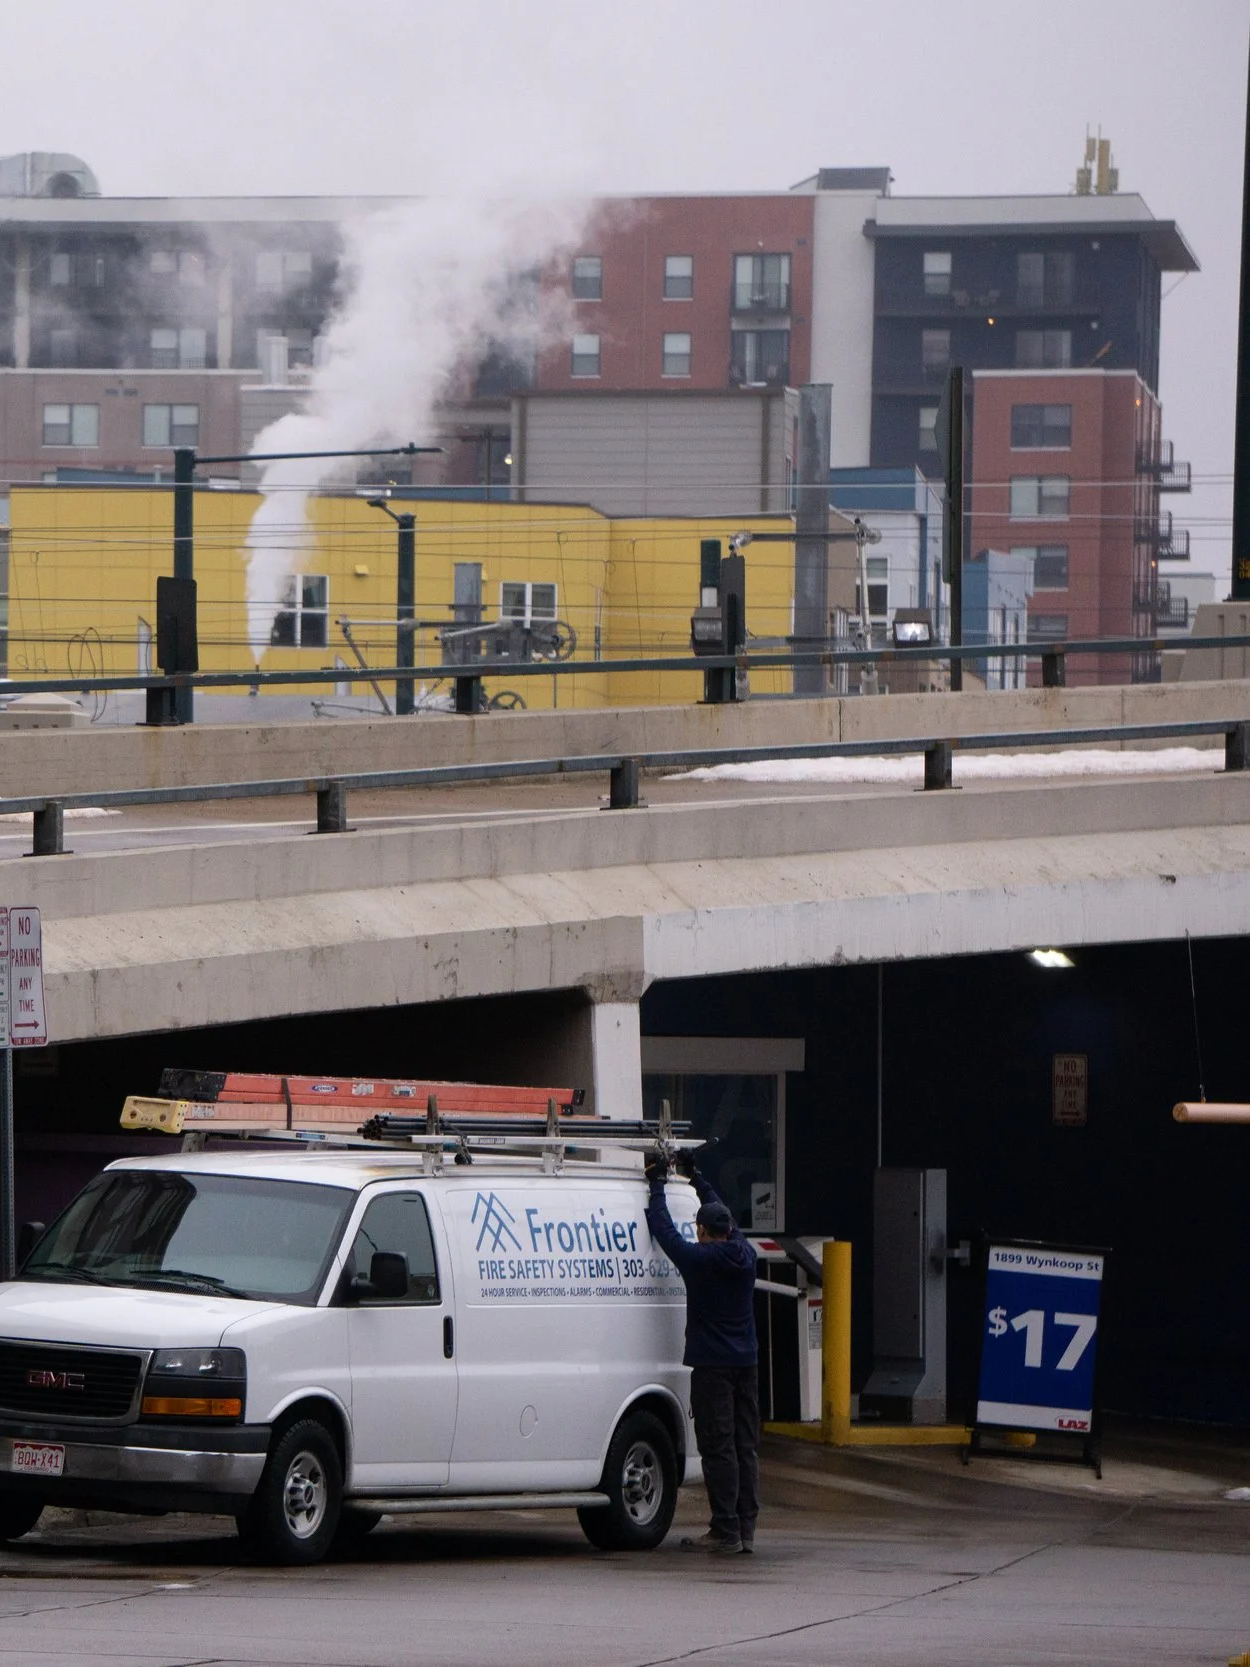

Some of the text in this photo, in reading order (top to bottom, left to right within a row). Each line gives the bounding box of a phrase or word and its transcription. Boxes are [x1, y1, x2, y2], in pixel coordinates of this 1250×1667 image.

[18, 916, 31, 936] NO
[12, 948, 40, 967] PARKING
[19, 977, 32, 990] ANY
[19, 999, 35, 1012] TIME
[1063, 1059, 1077, 1073] NO
[1055, 1074, 1085, 1088] PARKING
[525, 1208, 638, 1253] Frontier
[478, 1260, 507, 1280] FIRE
[509, 1259, 555, 1280] SAFETY
[558, 1258, 614, 1279] SYSTEMS
[994, 1253, 1100, 1271] 1899 Wynkoop St
[488, 1288, 506, 1298] HOUR
[506, 1288, 528, 1297] SERVICE
[531, 1287, 566, 1297] INSPECTIONS
[570, 1287, 592, 1296] ALARMS
[596, 1287, 630, 1296] COMMERCIAL
[634, 1286, 667, 1296] RESIDENTIAL
[28, 1370, 85, 1391] GMC
[1058, 1418, 1089, 1430] LAZ
